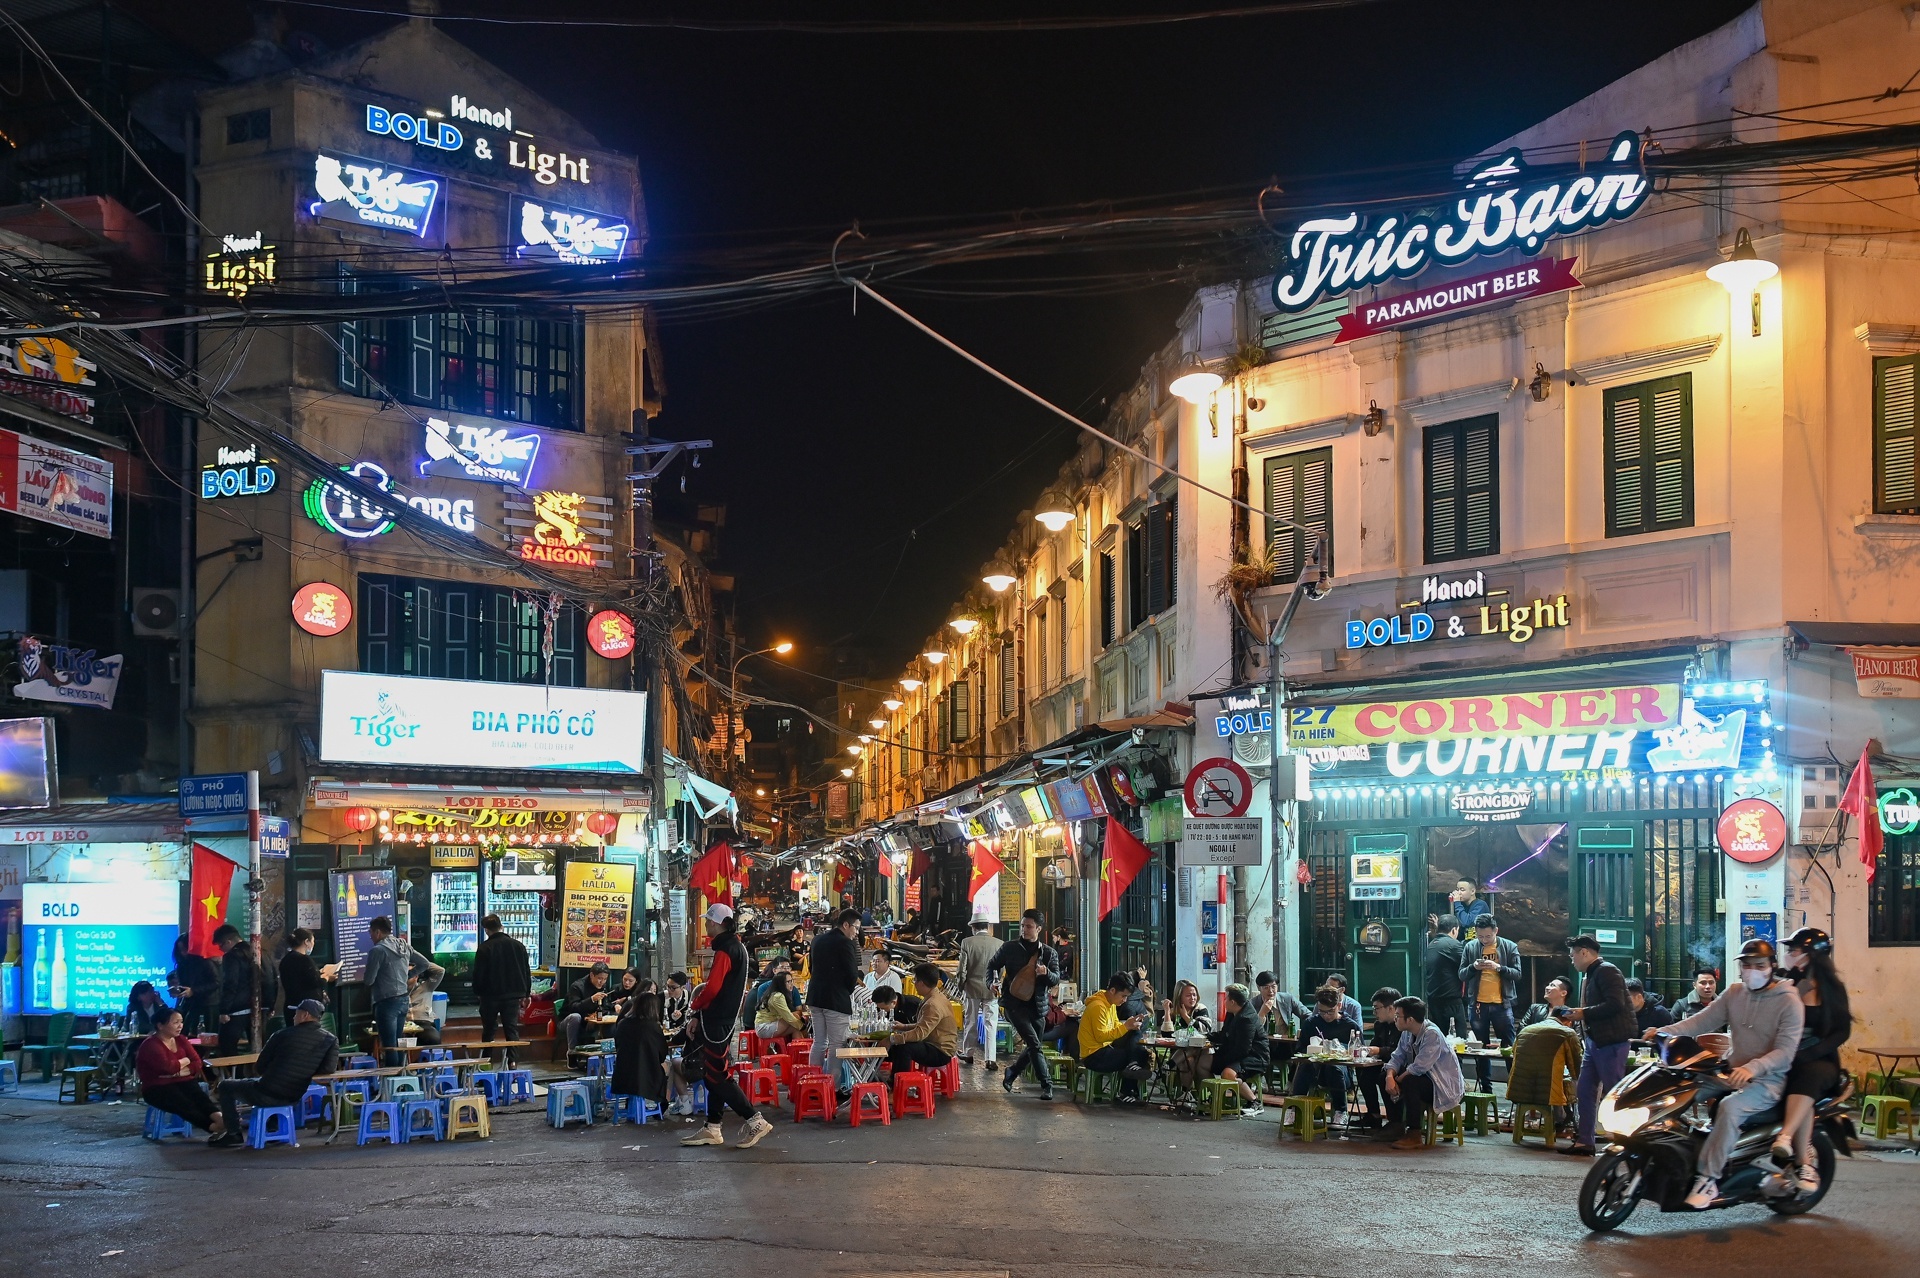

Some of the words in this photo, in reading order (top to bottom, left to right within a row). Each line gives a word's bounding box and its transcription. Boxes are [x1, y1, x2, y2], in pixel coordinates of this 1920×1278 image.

[451, 94, 512, 131] Hanoi
[366, 104, 463, 150] BOLD
[475, 138, 492, 160] &
[509, 140, 590, 185] Light
[345, 165, 431, 212] Tiger
[359, 209, 417, 230] CRYSTAL
[550, 210, 623, 254] Tiger
[1277, 212, 1428, 302] Trúc
[206, 253, 276, 297] Light
[1366, 280, 1488, 325] PARAMOUNT
[1492, 268, 1541, 295] BEER
[456, 425, 534, 465] Tiger
[201, 465, 276, 499] BOLD
[465, 465, 521, 482] CRYSTAL
[333, 484, 474, 531] TUORG
[547, 537, 566, 547] BIA
[521, 544, 595, 566] SAIGON
[1423, 570, 1485, 603] Hanoi
[1346, 612, 1435, 649] BOLD
[1447, 615, 1465, 638] &
[1480, 594, 1571, 643] Light
[50, 645, 119, 685] Tiger
[1855, 656, 1891, 676] HANOI
[1893, 659, 1919, 679] BEER
[58, 686, 109, 703] CRYSTAL
[472, 710, 509, 733] BIA
[517, 708, 563, 735] PHỐ
[567, 709, 596, 737] CỔ
[1292, 705, 1337, 726] 27
[1355, 687, 1669, 738] CORNER
[350, 714, 421, 747] Tiger
[1215, 711, 1271, 737] BOLD
[1292, 729, 1305, 742] TẠ
[1309, 728, 1335, 741] HIỆN
[1386, 729, 1638, 777] CORNER
[202, 779, 224, 791] PHỐ
[1562, 769, 1577, 781] 27
[491, 795, 538, 808] BÉO
[1451, 793, 1531, 810] STRONGBOW
[1464, 814, 1489, 822] APPLE
[1491, 811, 1521, 821] CIDERS
[52, 826, 89, 841] BÉO
[268, 822, 280, 833] PHỐ
[262, 836, 270, 852] TẠ
[271, 835, 286, 853] HIỆN
[435, 848, 474, 858] HALIDA
[1209, 844, 1228, 854] NGOẠI
[1229, 843, 1236, 854] LỆ
[1731, 842, 1770, 851] SAIGON
[1211, 855, 1235, 863] Except
[582, 880, 616, 889] HALIDA
[589, 894, 609, 902] PHỐ
[42, 903, 80, 917] BOLD
